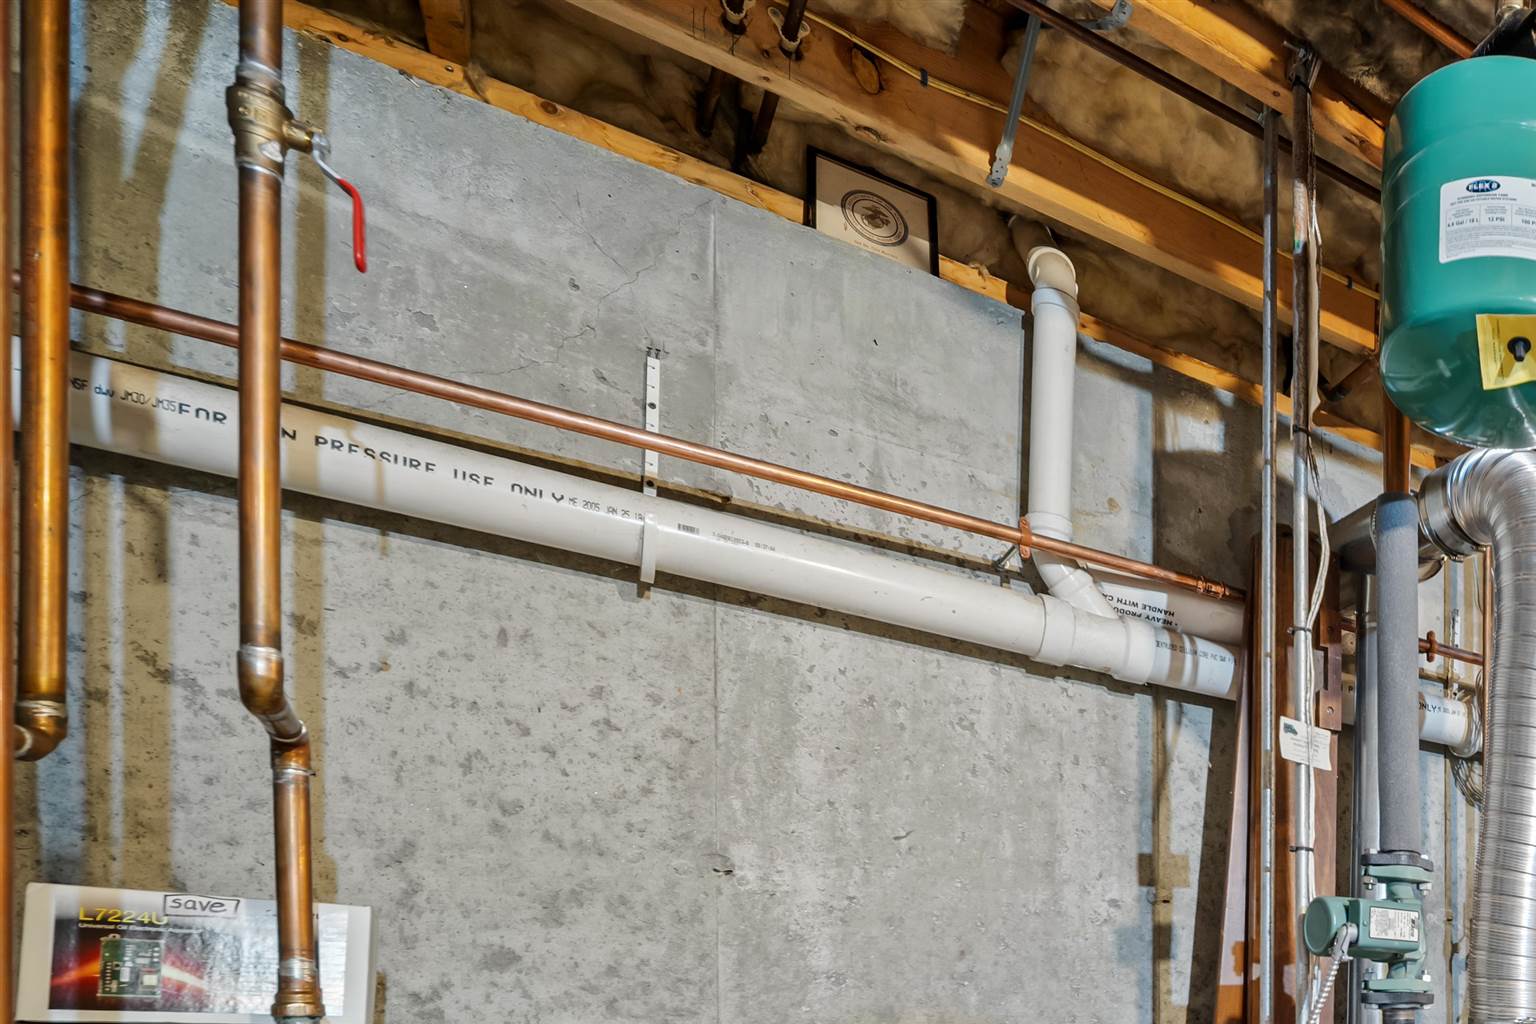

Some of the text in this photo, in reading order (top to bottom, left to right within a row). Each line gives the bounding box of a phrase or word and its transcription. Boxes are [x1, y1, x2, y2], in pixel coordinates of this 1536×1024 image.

[314, 434, 437, 473] PRESSURE
[1102, 593, 1175, 617] HANDLE WITH CA
[1113, 606, 1173, 627] HEAVY PRODU
[79, 906, 169, 925] L7224U
[169, 897, 228, 914] save
